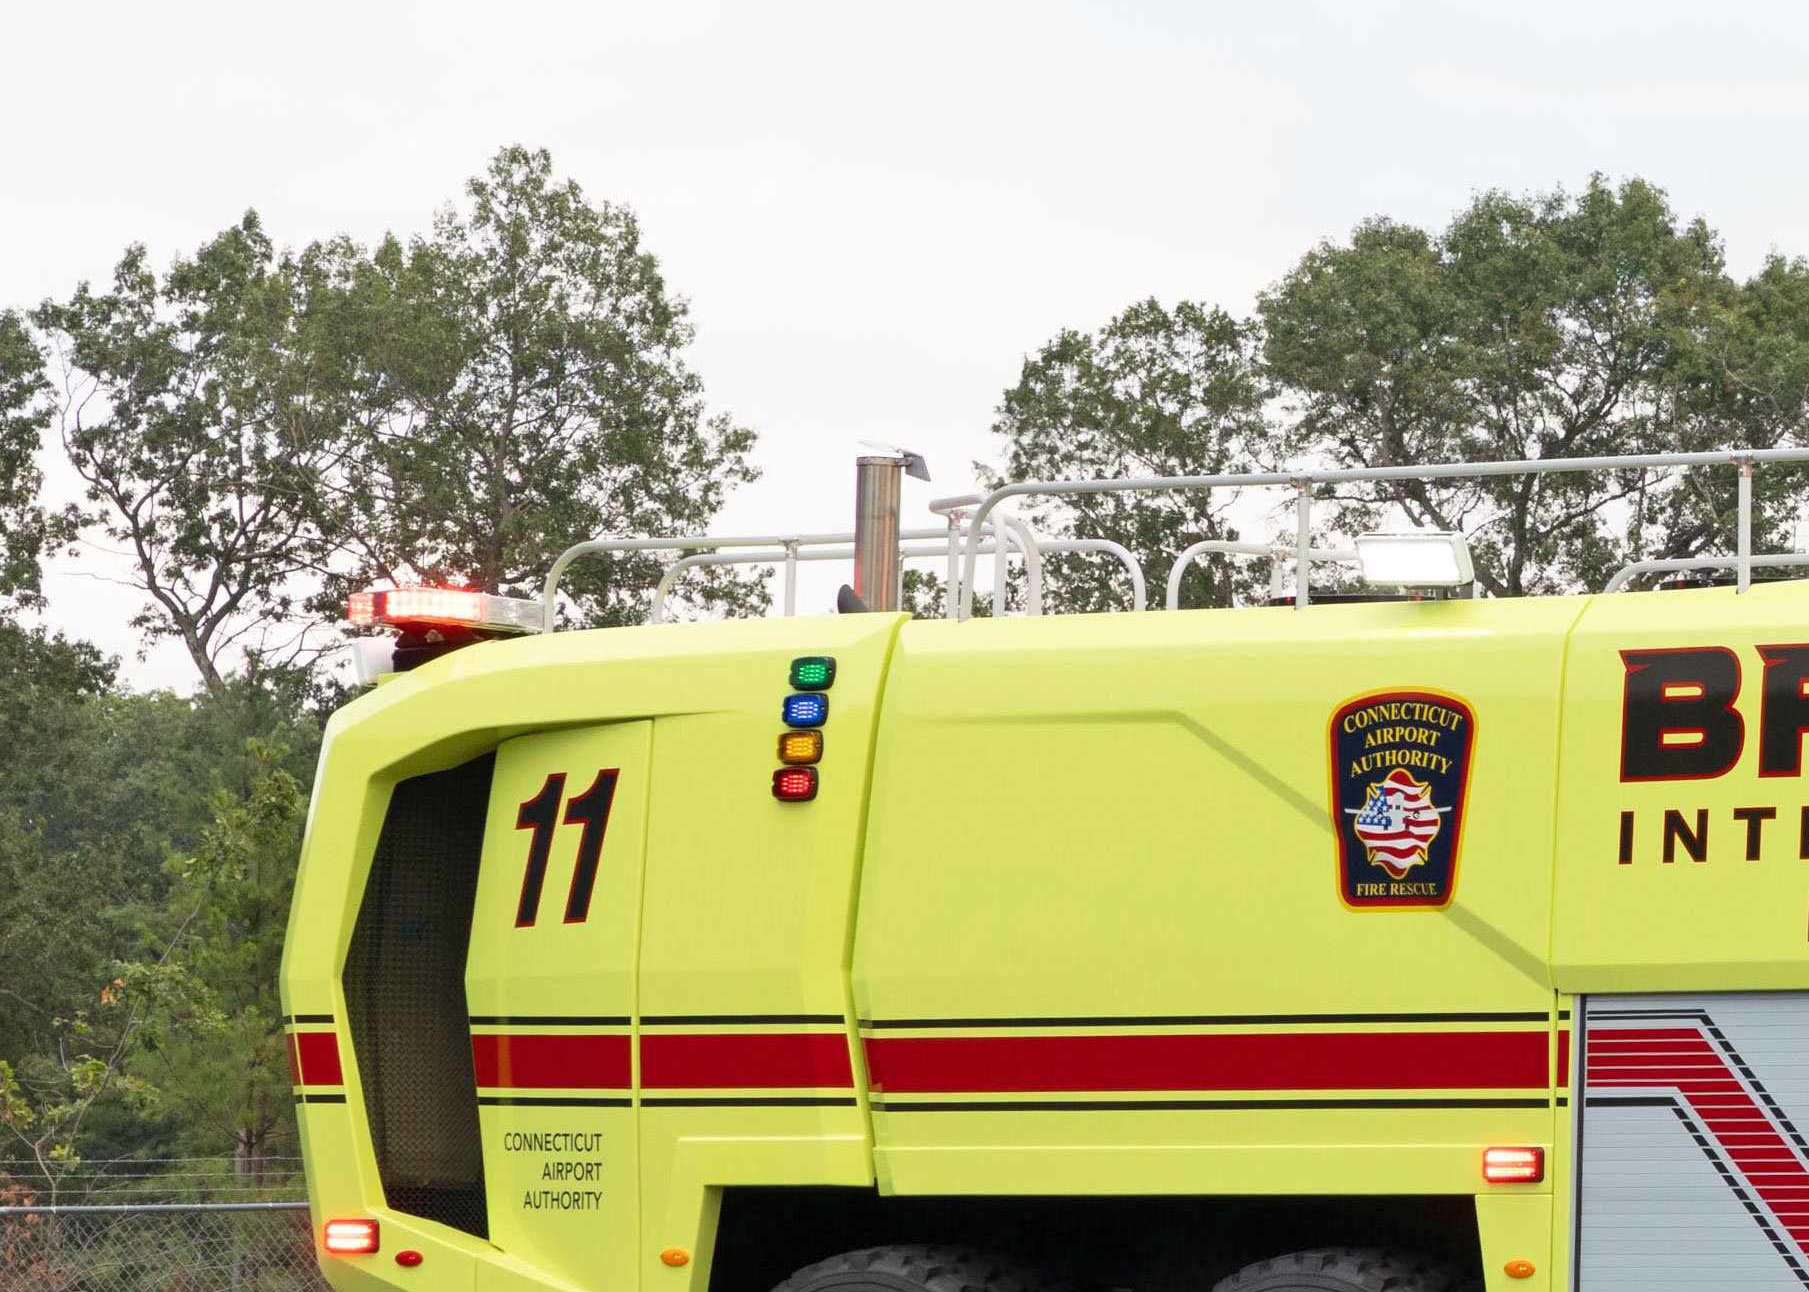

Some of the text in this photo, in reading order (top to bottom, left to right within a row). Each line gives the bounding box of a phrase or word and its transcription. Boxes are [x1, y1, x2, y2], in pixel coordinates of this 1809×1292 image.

[1343, 702, 1463, 733] CONNECTICUT
[1365, 726, 1441, 748] AIRPORT
[1351, 749, 1453, 778] AUTHORITY
[514, 767, 621, 929] 11
[1357, 882, 1437, 896] FIRE RESCUE
[504, 1132, 603, 1152] CONNECTICUT
[541, 1161, 603, 1182] AIRPORT
[523, 1190, 603, 1210] AUTHORITY
